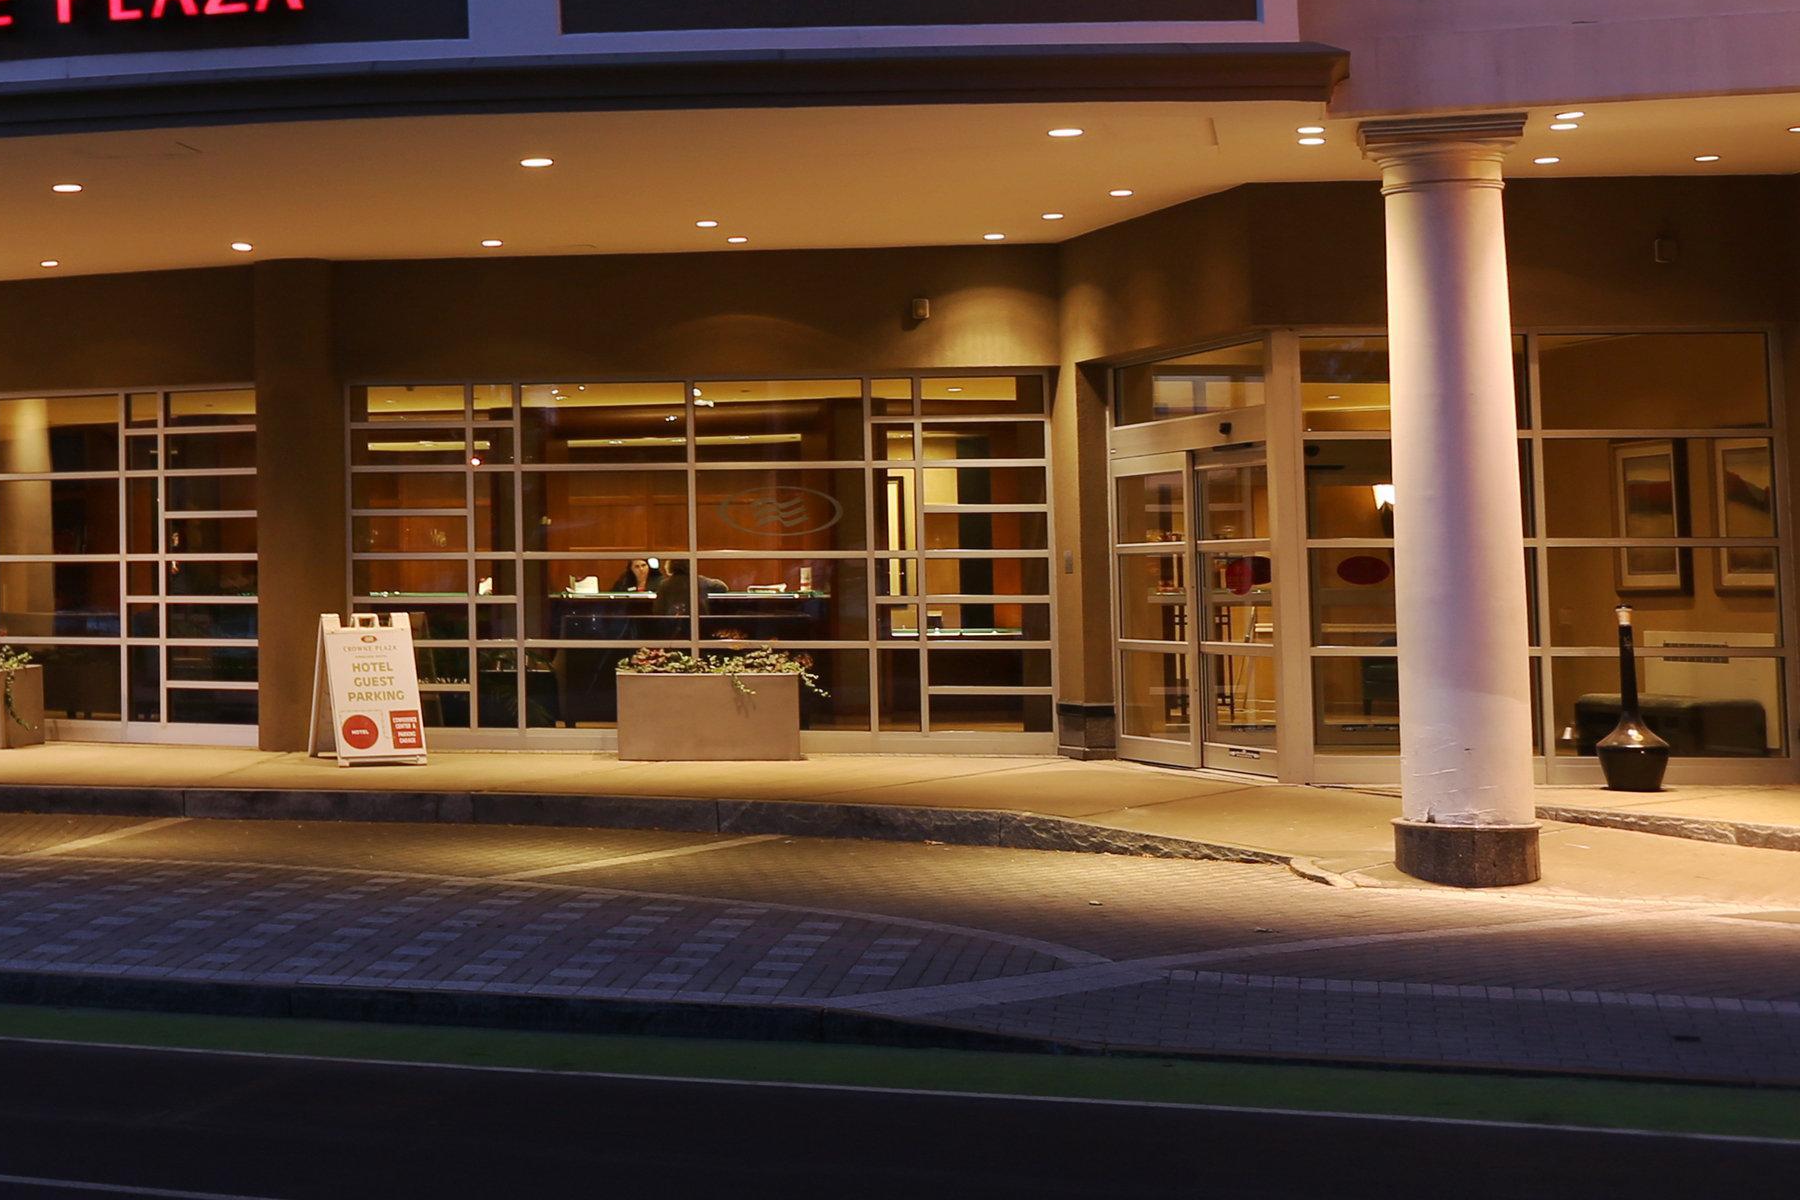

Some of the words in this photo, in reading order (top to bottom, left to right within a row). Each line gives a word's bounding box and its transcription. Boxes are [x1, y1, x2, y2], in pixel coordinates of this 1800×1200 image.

[352, 662, 393, 672] HOTEL
[354, 676, 394, 687] GUEST
[347, 690, 405, 702] PARKING
